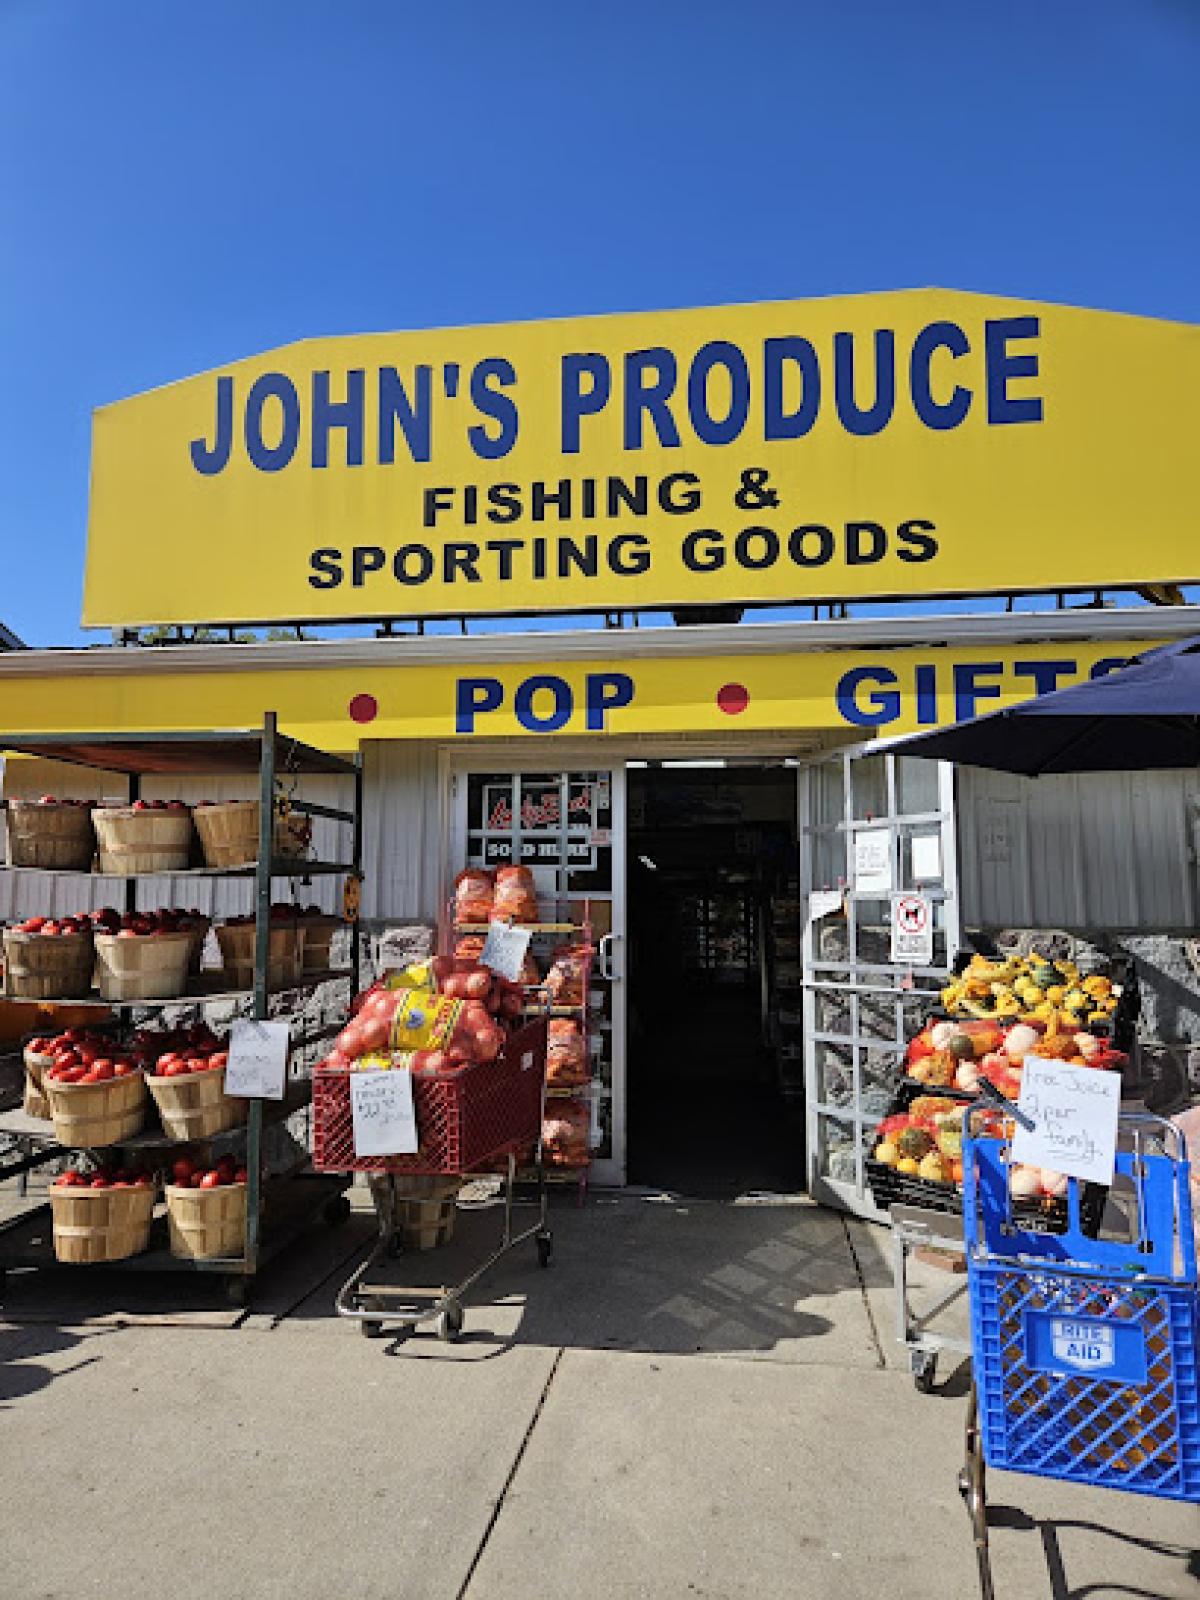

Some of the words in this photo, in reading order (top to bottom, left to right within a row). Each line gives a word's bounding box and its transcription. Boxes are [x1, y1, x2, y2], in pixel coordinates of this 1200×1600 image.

[190, 357, 520, 476] JOHN'S
[561, 315, 1045, 454] PRODUCE
[423, 475, 702, 528] FISHING
[734, 467, 781, 511] &
[308, 534, 651, 589] SPORTING
[681, 519, 939, 572] GOODS
[455, 673, 636, 734] POP
[1067, 1343, 1101, 1360] AID
